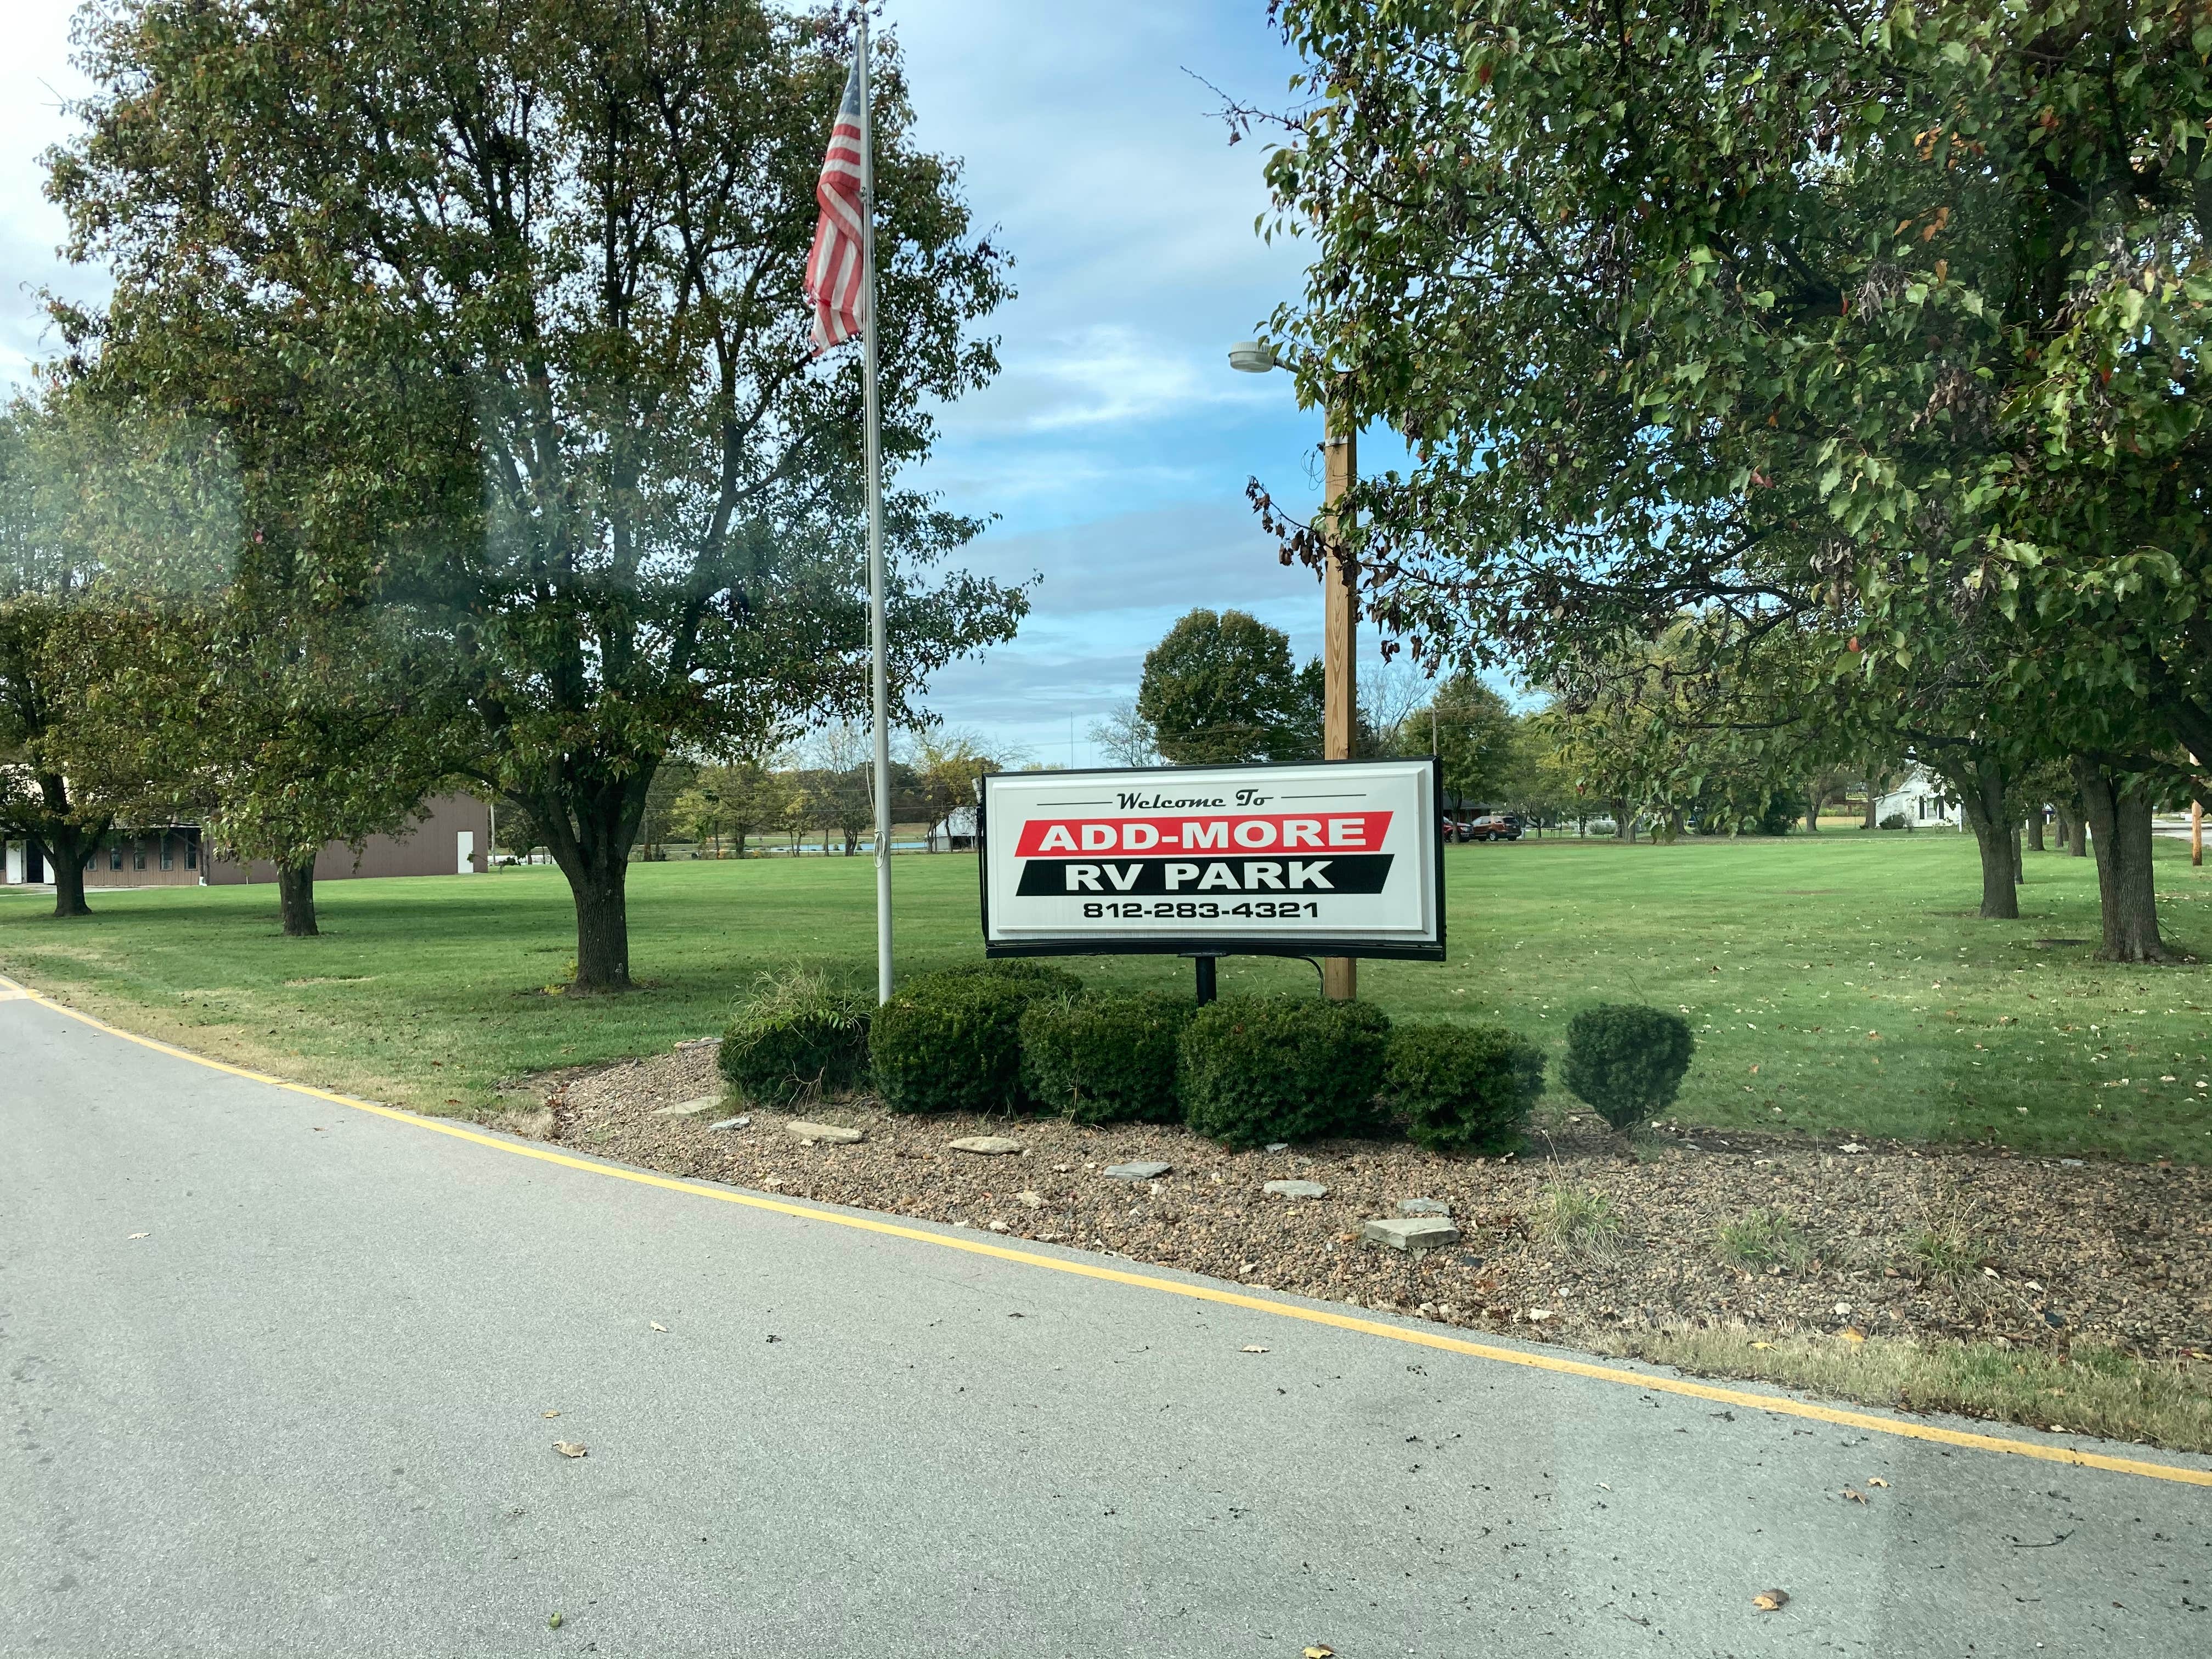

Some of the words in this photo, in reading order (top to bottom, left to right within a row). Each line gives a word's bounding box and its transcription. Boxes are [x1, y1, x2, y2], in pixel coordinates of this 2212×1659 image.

[1116, 792, 1226, 809] Welcome
[1235, 789, 1274, 806] To
[1037, 818, 1367, 851] ADD-MORE
[1065, 863, 1144, 890] RV
[1164, 861, 1335, 890] PARK
[1083, 902, 1318, 918] 812-283-4321
